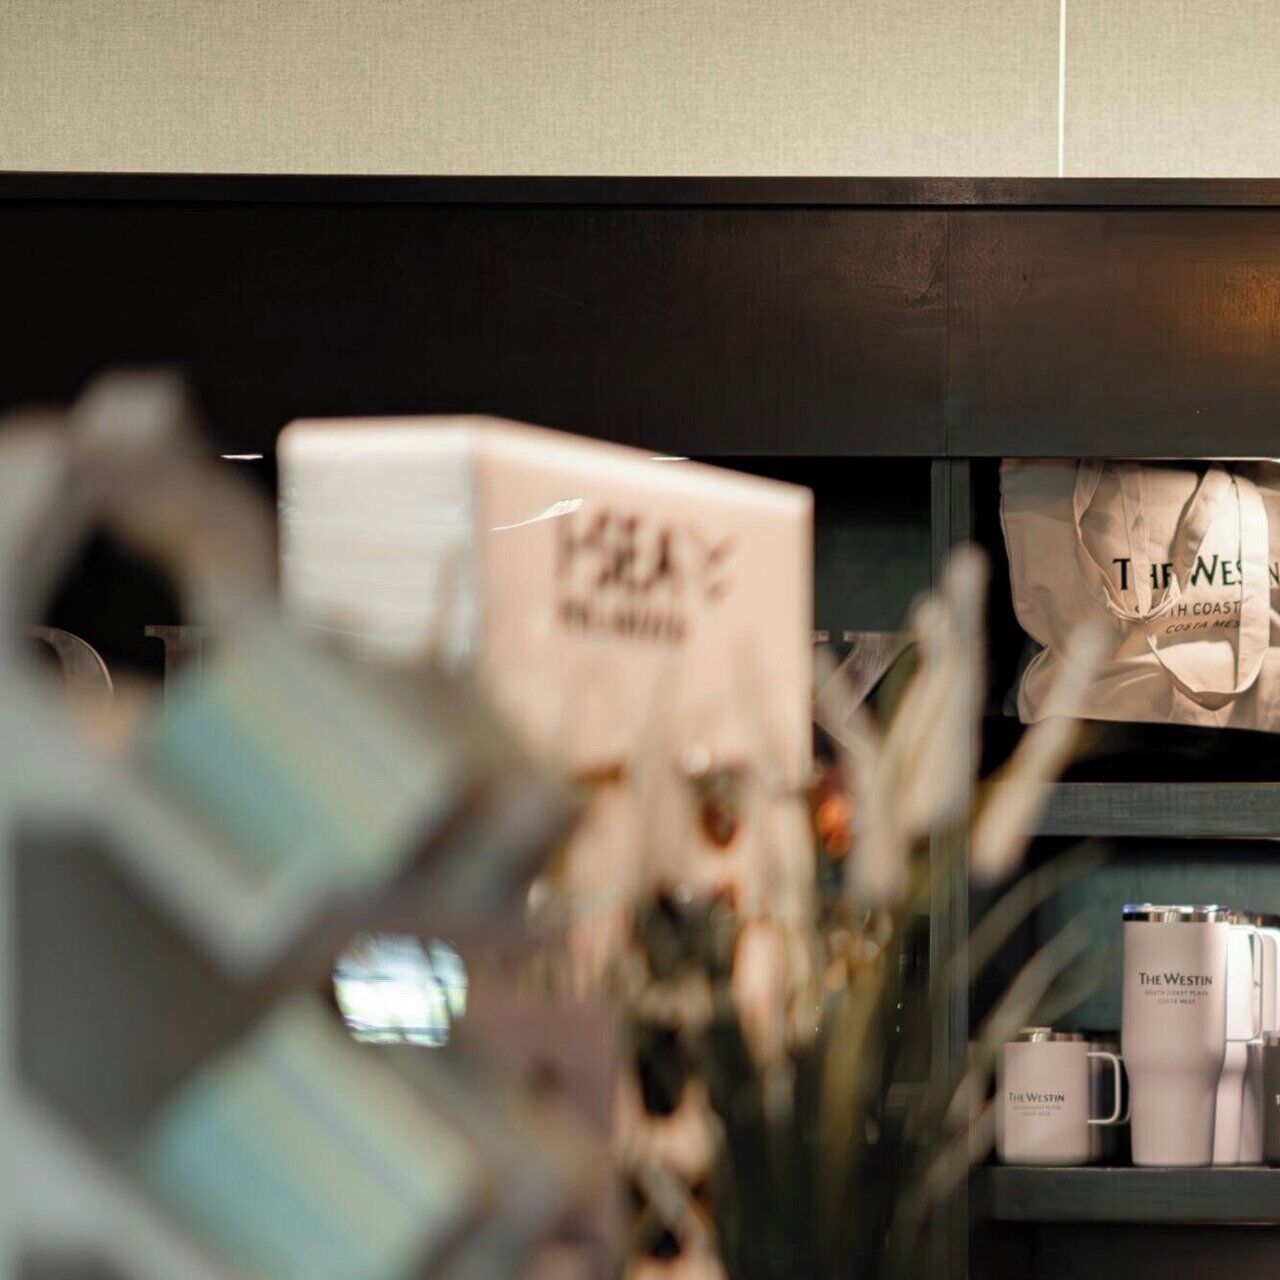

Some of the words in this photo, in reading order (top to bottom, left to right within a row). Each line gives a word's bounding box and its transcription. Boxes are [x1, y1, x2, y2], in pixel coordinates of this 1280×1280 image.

[1190, 554, 1280, 588] WESN
[1193, 600, 1241, 616] COAST
[1165, 621, 1208, 635] COSTA
[1212, 619, 1241, 631] MES
[1139, 972, 1162, 986] THE
[1163, 973, 1213, 987] WESTIN
[1026, 1092, 1065, 1103] WESTIN
